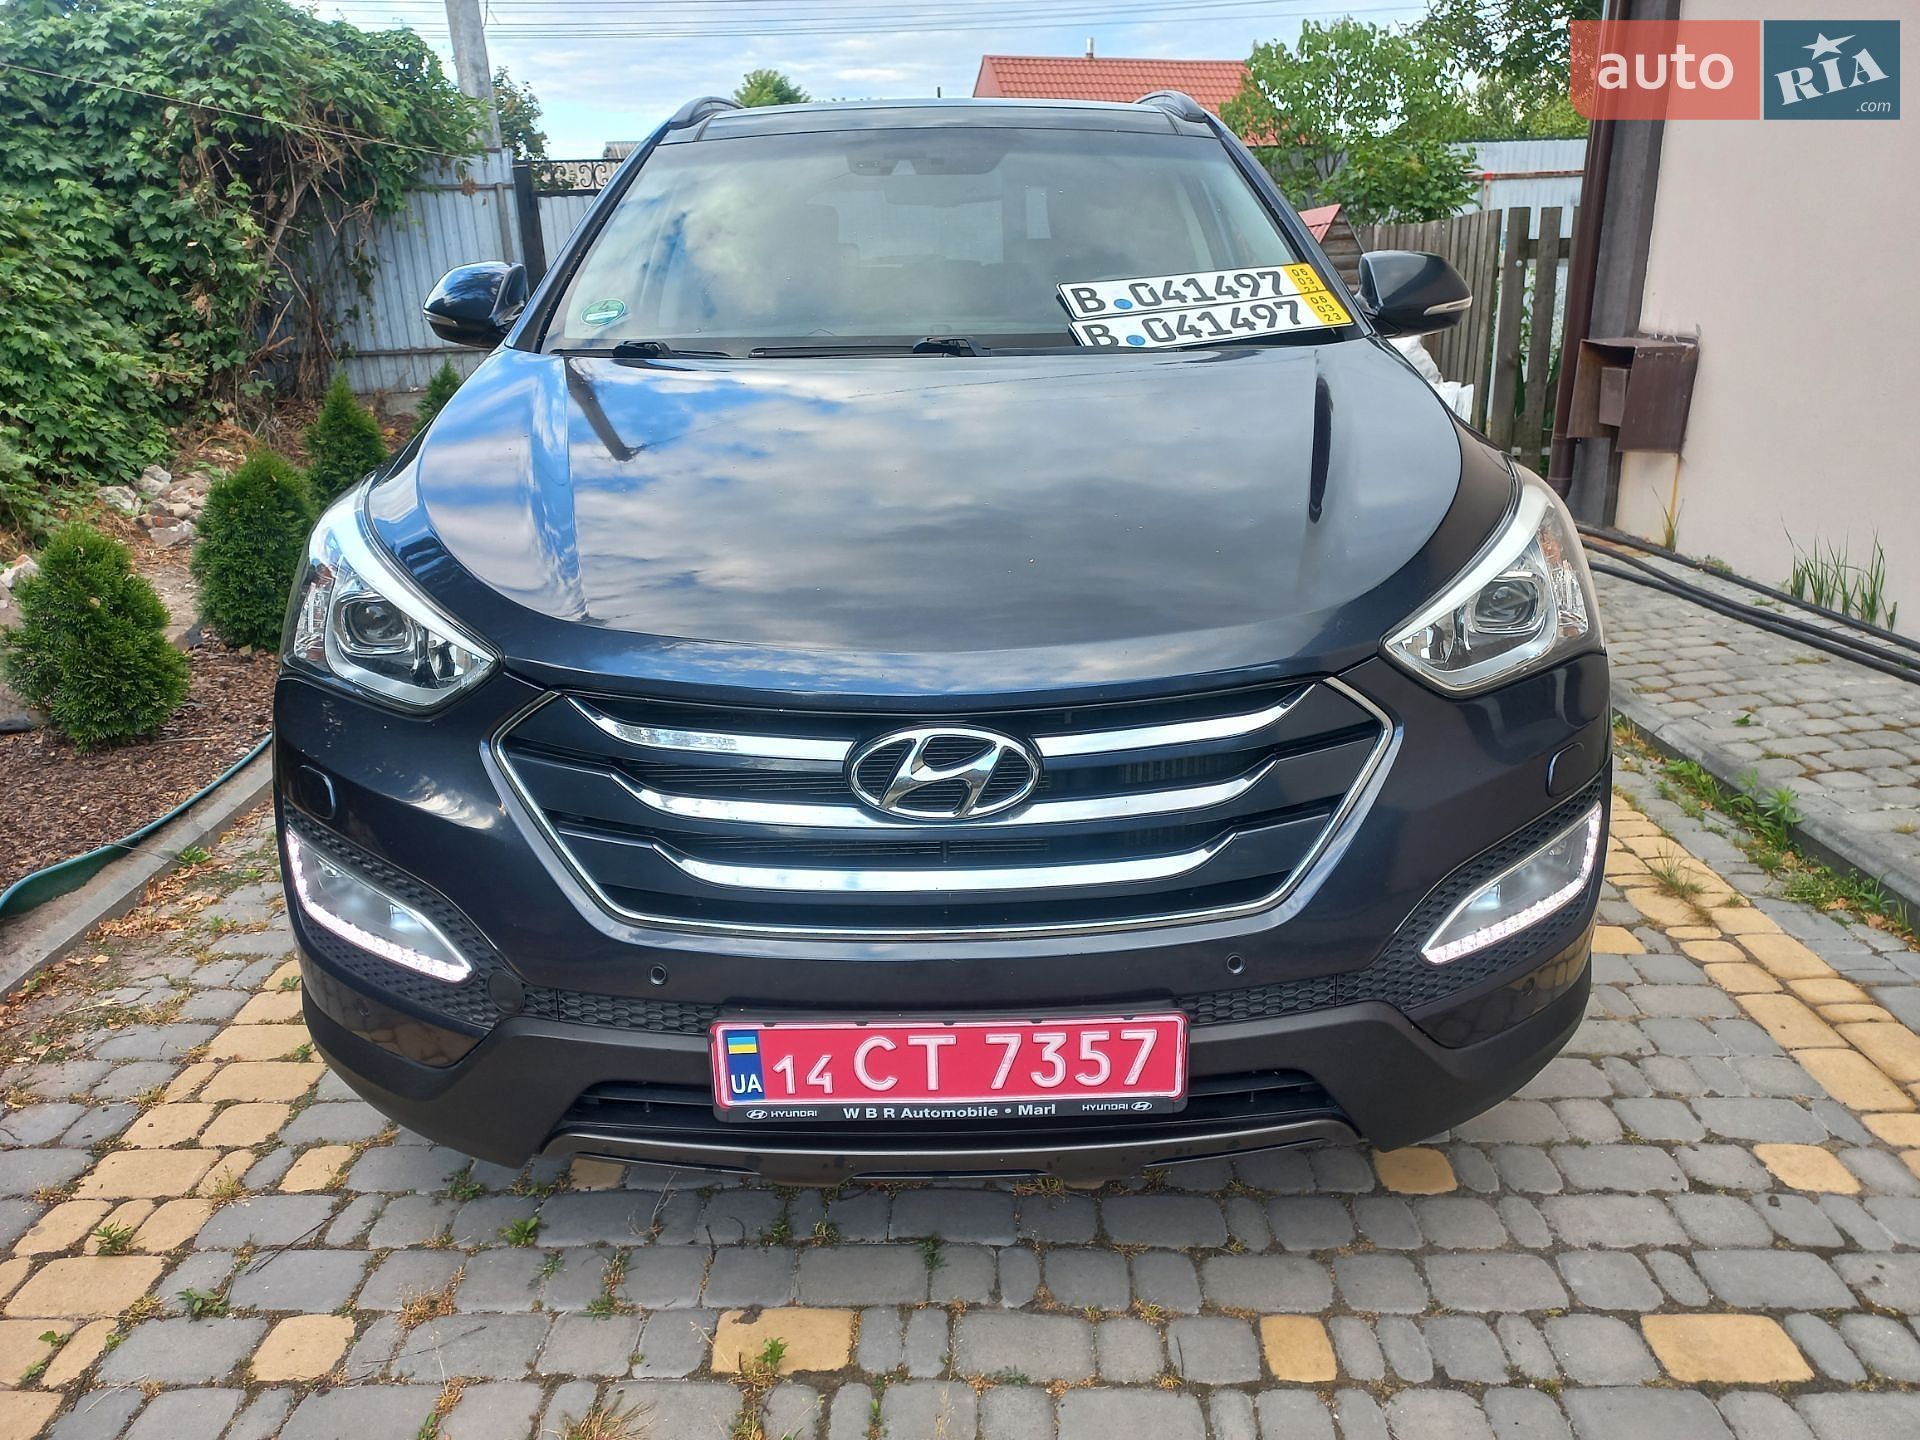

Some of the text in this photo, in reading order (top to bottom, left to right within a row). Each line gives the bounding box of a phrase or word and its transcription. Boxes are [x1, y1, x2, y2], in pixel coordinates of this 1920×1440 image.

[1070, 271, 1282, 313] B 041497
[1082, 300, 1301, 346] B 041497
[772, 1028, 1158, 1094] 14 CT 7357
[730, 1073, 763, 1095] UA
[769, 1110, 818, 1118] HYUNDAI
[900, 1106, 998, 1119] Automobile
[1018, 1103, 1056, 1116] Marl
[1081, 1103, 1129, 1112] HYUNDAI
